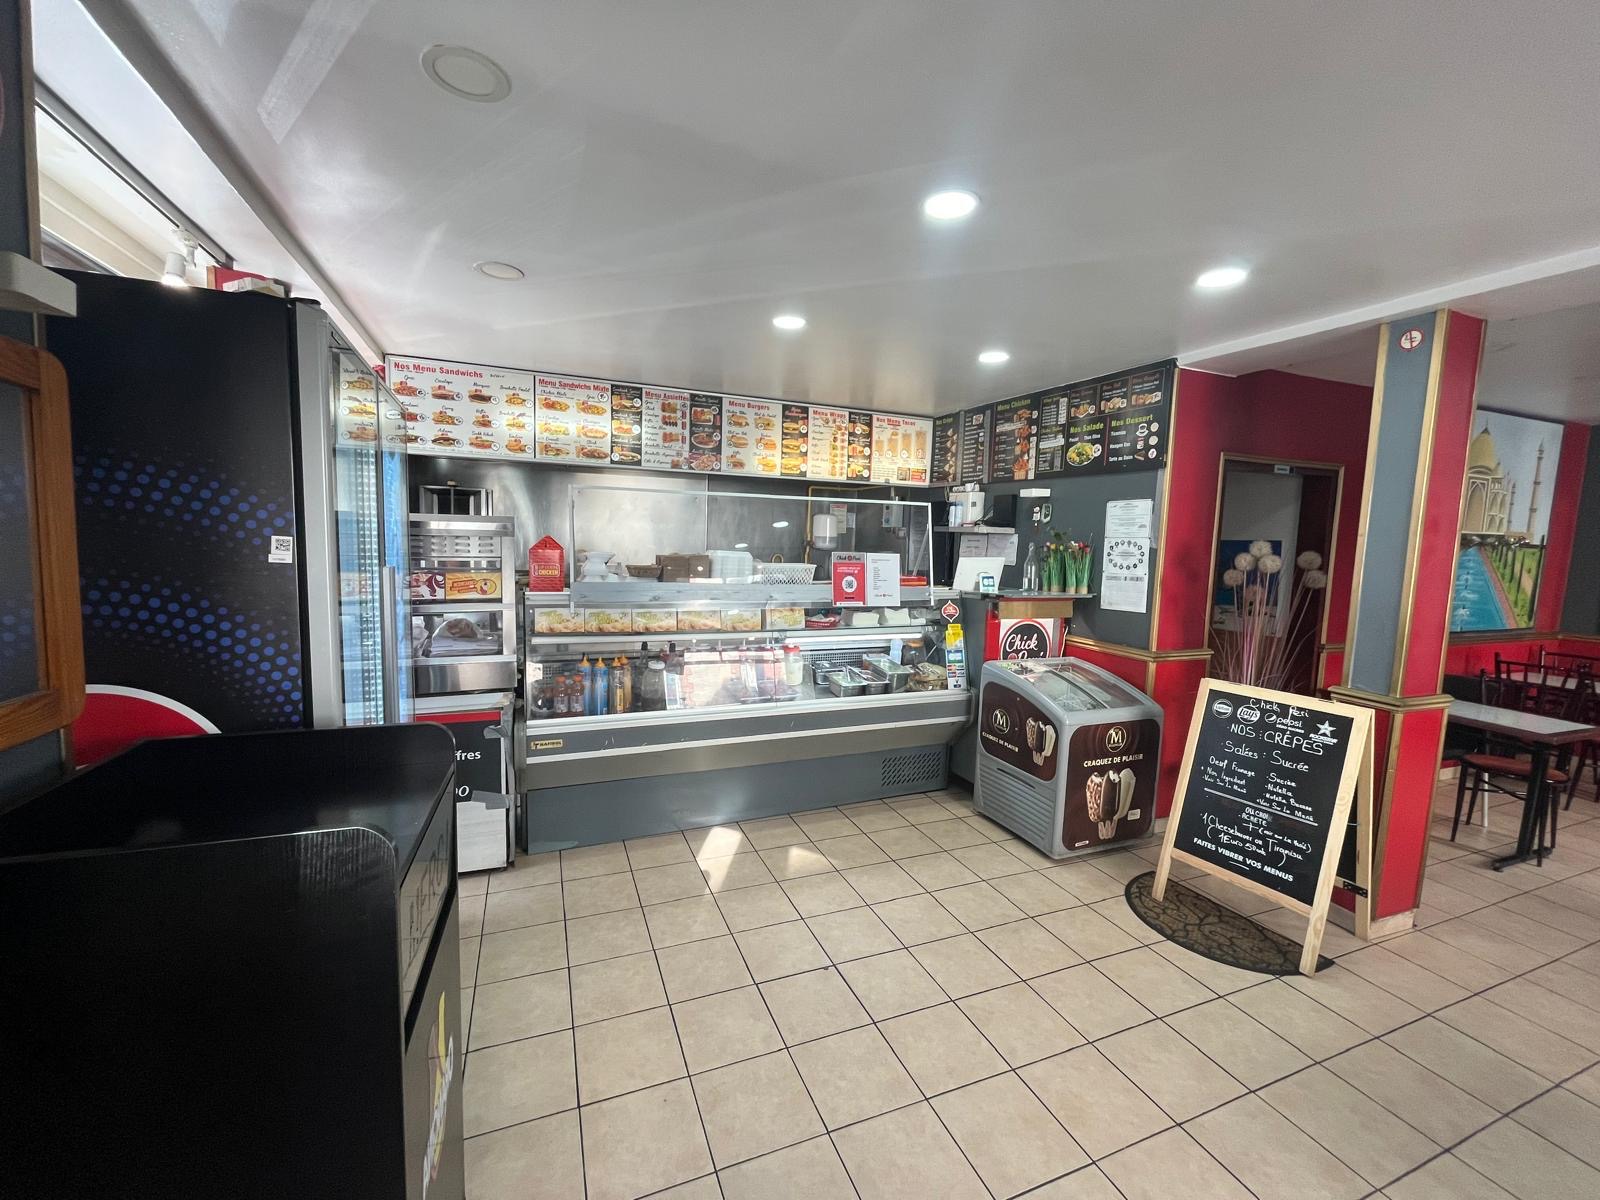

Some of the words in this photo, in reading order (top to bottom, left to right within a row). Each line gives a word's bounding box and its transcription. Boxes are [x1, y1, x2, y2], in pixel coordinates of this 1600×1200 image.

[394, 361, 410, 370] Nos
[412, 364, 436, 373] Menu
[439, 366, 483, 378] Sandwichs
[538, 378, 557, 386] Menu
[558, 381, 592, 390] Sandwichs
[593, 384, 610, 392] Mixte
[645, 391, 662, 399] Menu
[728, 400, 745, 408] Menu
[747, 402, 770, 411] Burgers
[1011, 399, 1031, 408] Chicken
[1111, 419, 1124, 427] Nos
[1070, 426, 1081, 434] Nos
[1006, 633, 1039, 652] Chick
[1277, 717, 1303, 727] pepsi
[1230, 723, 1256, 738] NOS
[454, 750, 481, 760] fres
[1083, 757, 1112, 768] CRAQUEZ
[1121, 753, 1144, 762] PLAISIR
[1193, 837, 1216, 851] FAITES
[1217, 845, 1244, 862] VIBRER
[1245, 857, 1263, 871] VOS
[1263, 864, 1294, 882] MENUS
